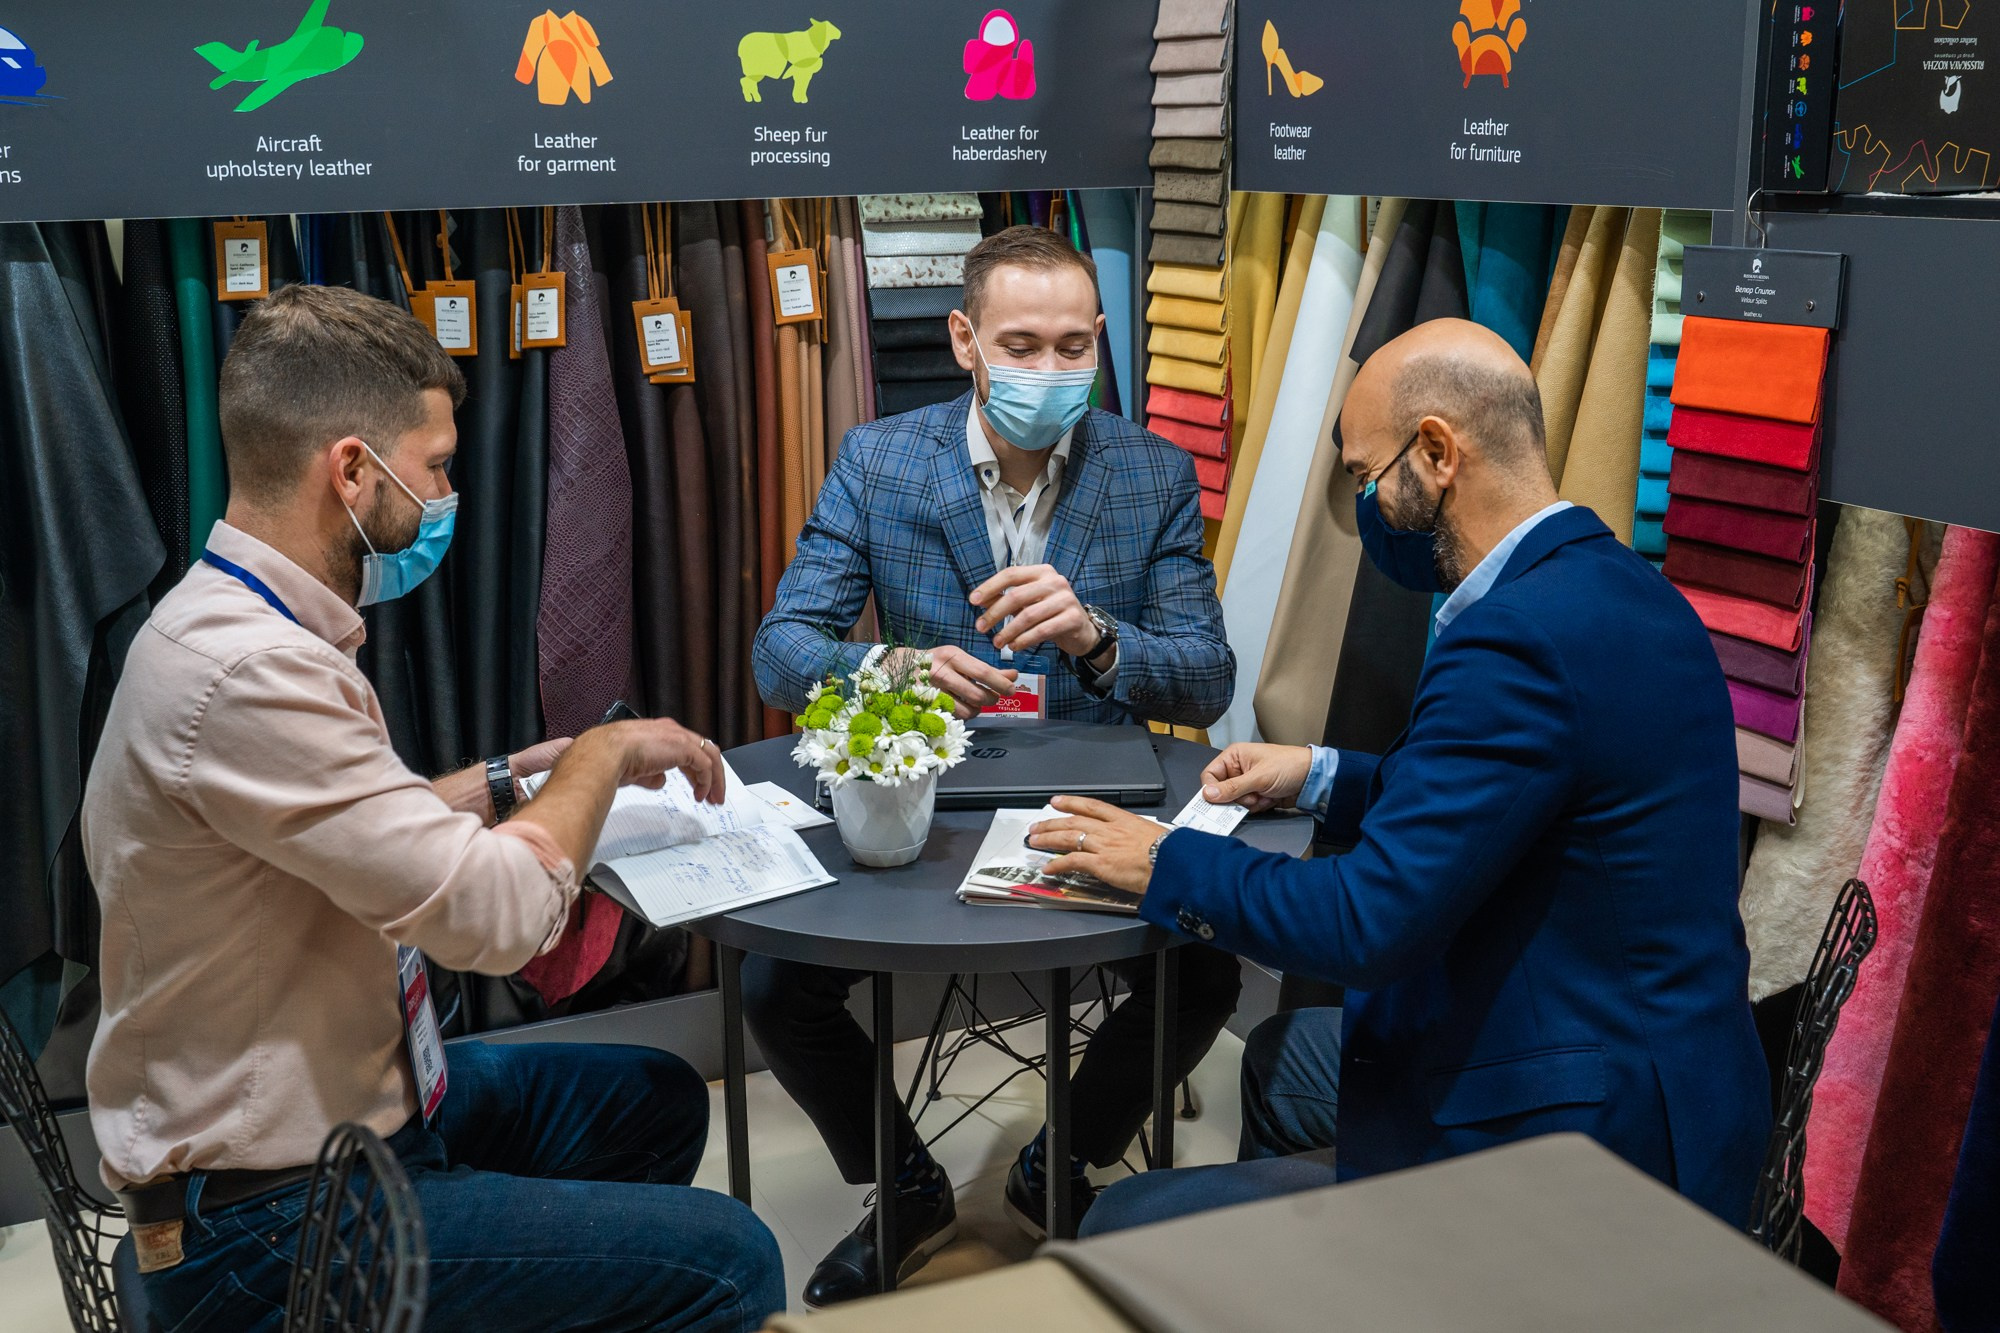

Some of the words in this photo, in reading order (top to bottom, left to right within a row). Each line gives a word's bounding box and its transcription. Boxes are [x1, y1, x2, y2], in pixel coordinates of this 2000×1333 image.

[1922, 60, 1949, 70] KOZHA
[1949, 60, 1985, 70] RUSSKAYA
[753, 126, 801, 145] Sheep
[804, 127, 828, 143] fur
[961, 125, 1016, 141] Leather
[1019, 125, 1040, 141] for
[1269, 122, 1312, 138] Footwear
[1463, 117, 1510, 137] Leather
[256, 134, 323, 153] Aircraft
[534, 132, 598, 149] Leather
[750, 149, 831, 168] processing
[952, 145, 1048, 164] haberdashery
[1274, 144, 1307, 161] leather
[1450, 142, 1467, 160] for
[1469, 143, 1522, 164] furniture
[206, 159, 304, 181] upholstery
[309, 158, 373, 177] leather
[517, 154, 542, 172] for
[546, 157, 617, 175] garment
[1754, 286, 1776, 296] Спилок
[1755, 297, 1768, 305] Splits
[996, 698, 1021, 708] EXPO
